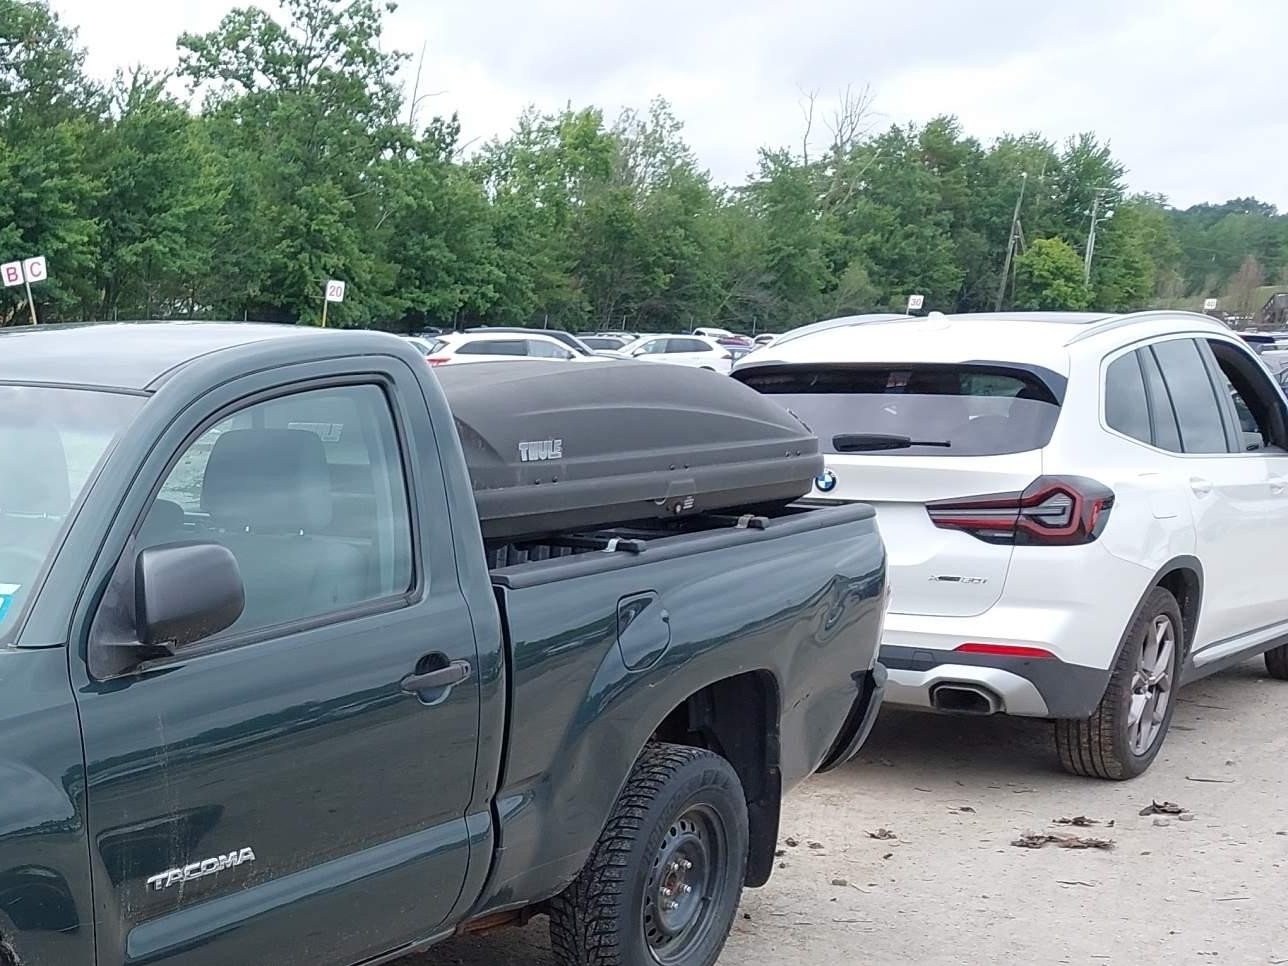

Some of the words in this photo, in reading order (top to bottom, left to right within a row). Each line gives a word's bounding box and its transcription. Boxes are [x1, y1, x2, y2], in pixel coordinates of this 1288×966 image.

[5, 266, 19, 283] B
[29, 260, 43, 278] C
[328, 284, 343, 298] 20
[518, 439, 562, 462] THULE
[146, 846, 256, 891] TACOMA
